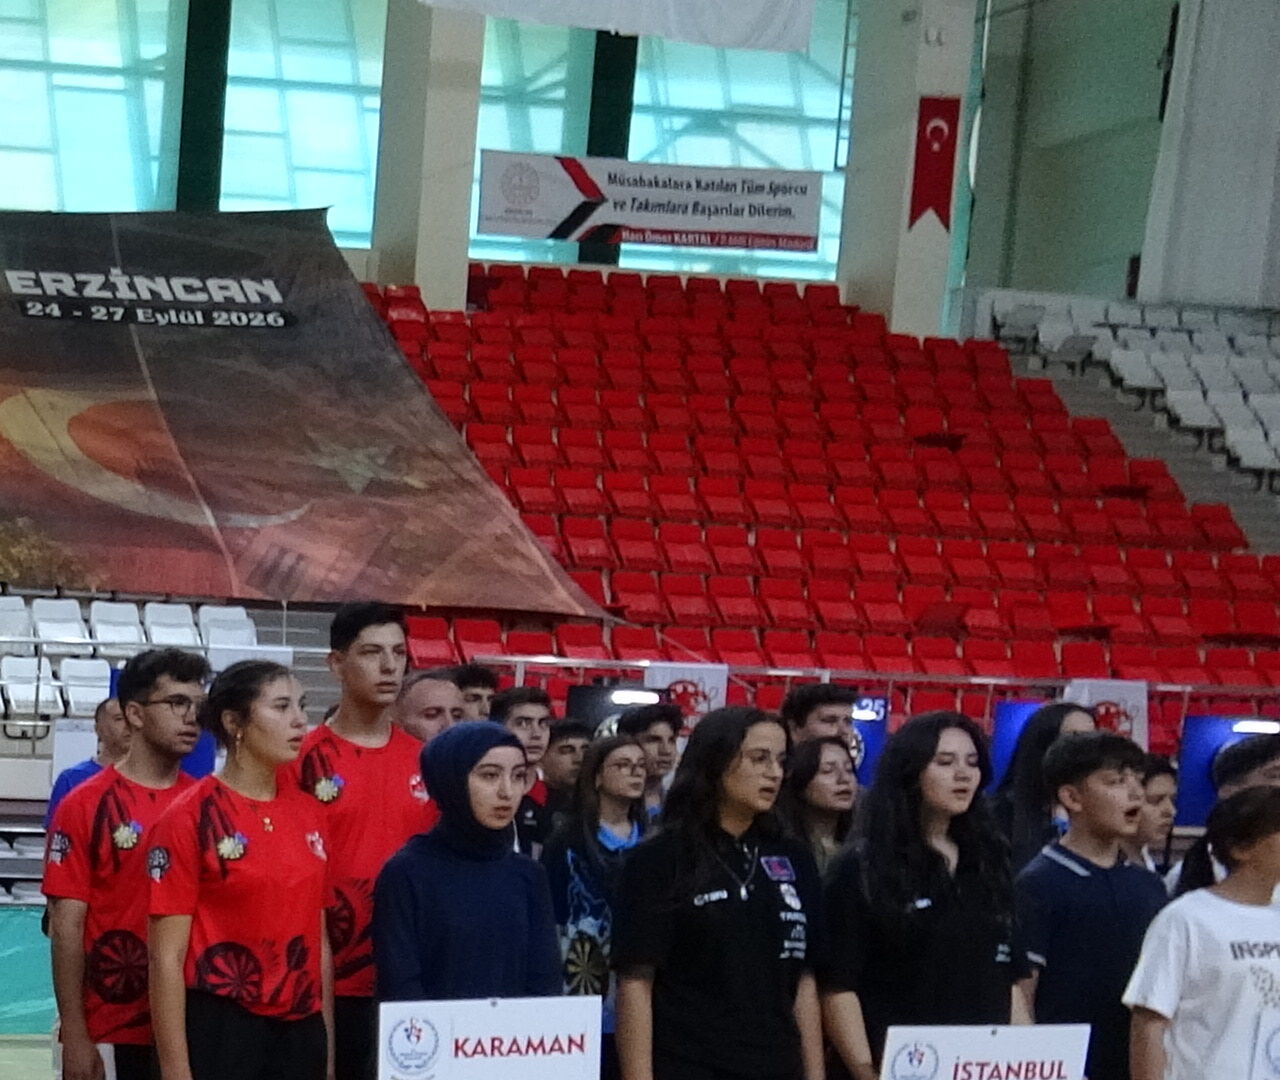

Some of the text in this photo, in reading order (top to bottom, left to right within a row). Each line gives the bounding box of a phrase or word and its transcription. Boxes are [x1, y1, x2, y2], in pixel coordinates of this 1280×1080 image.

[608, 172, 692, 192] Müsabakalara
[769, 182, 808, 198] Sporcu
[613, 202, 626, 212] ve
[630, 198, 689, 215] Takımlara
[692, 202, 745, 220] Başarılar
[4, 267, 283, 304] ERZİNCAN
[26, 301, 62, 318] 24
[90, 305, 125, 321] 27
[136, 308, 205, 326] Eylül
[211, 311, 286, 327] 2026
[452, 1034, 586, 1059] KARAMAN
